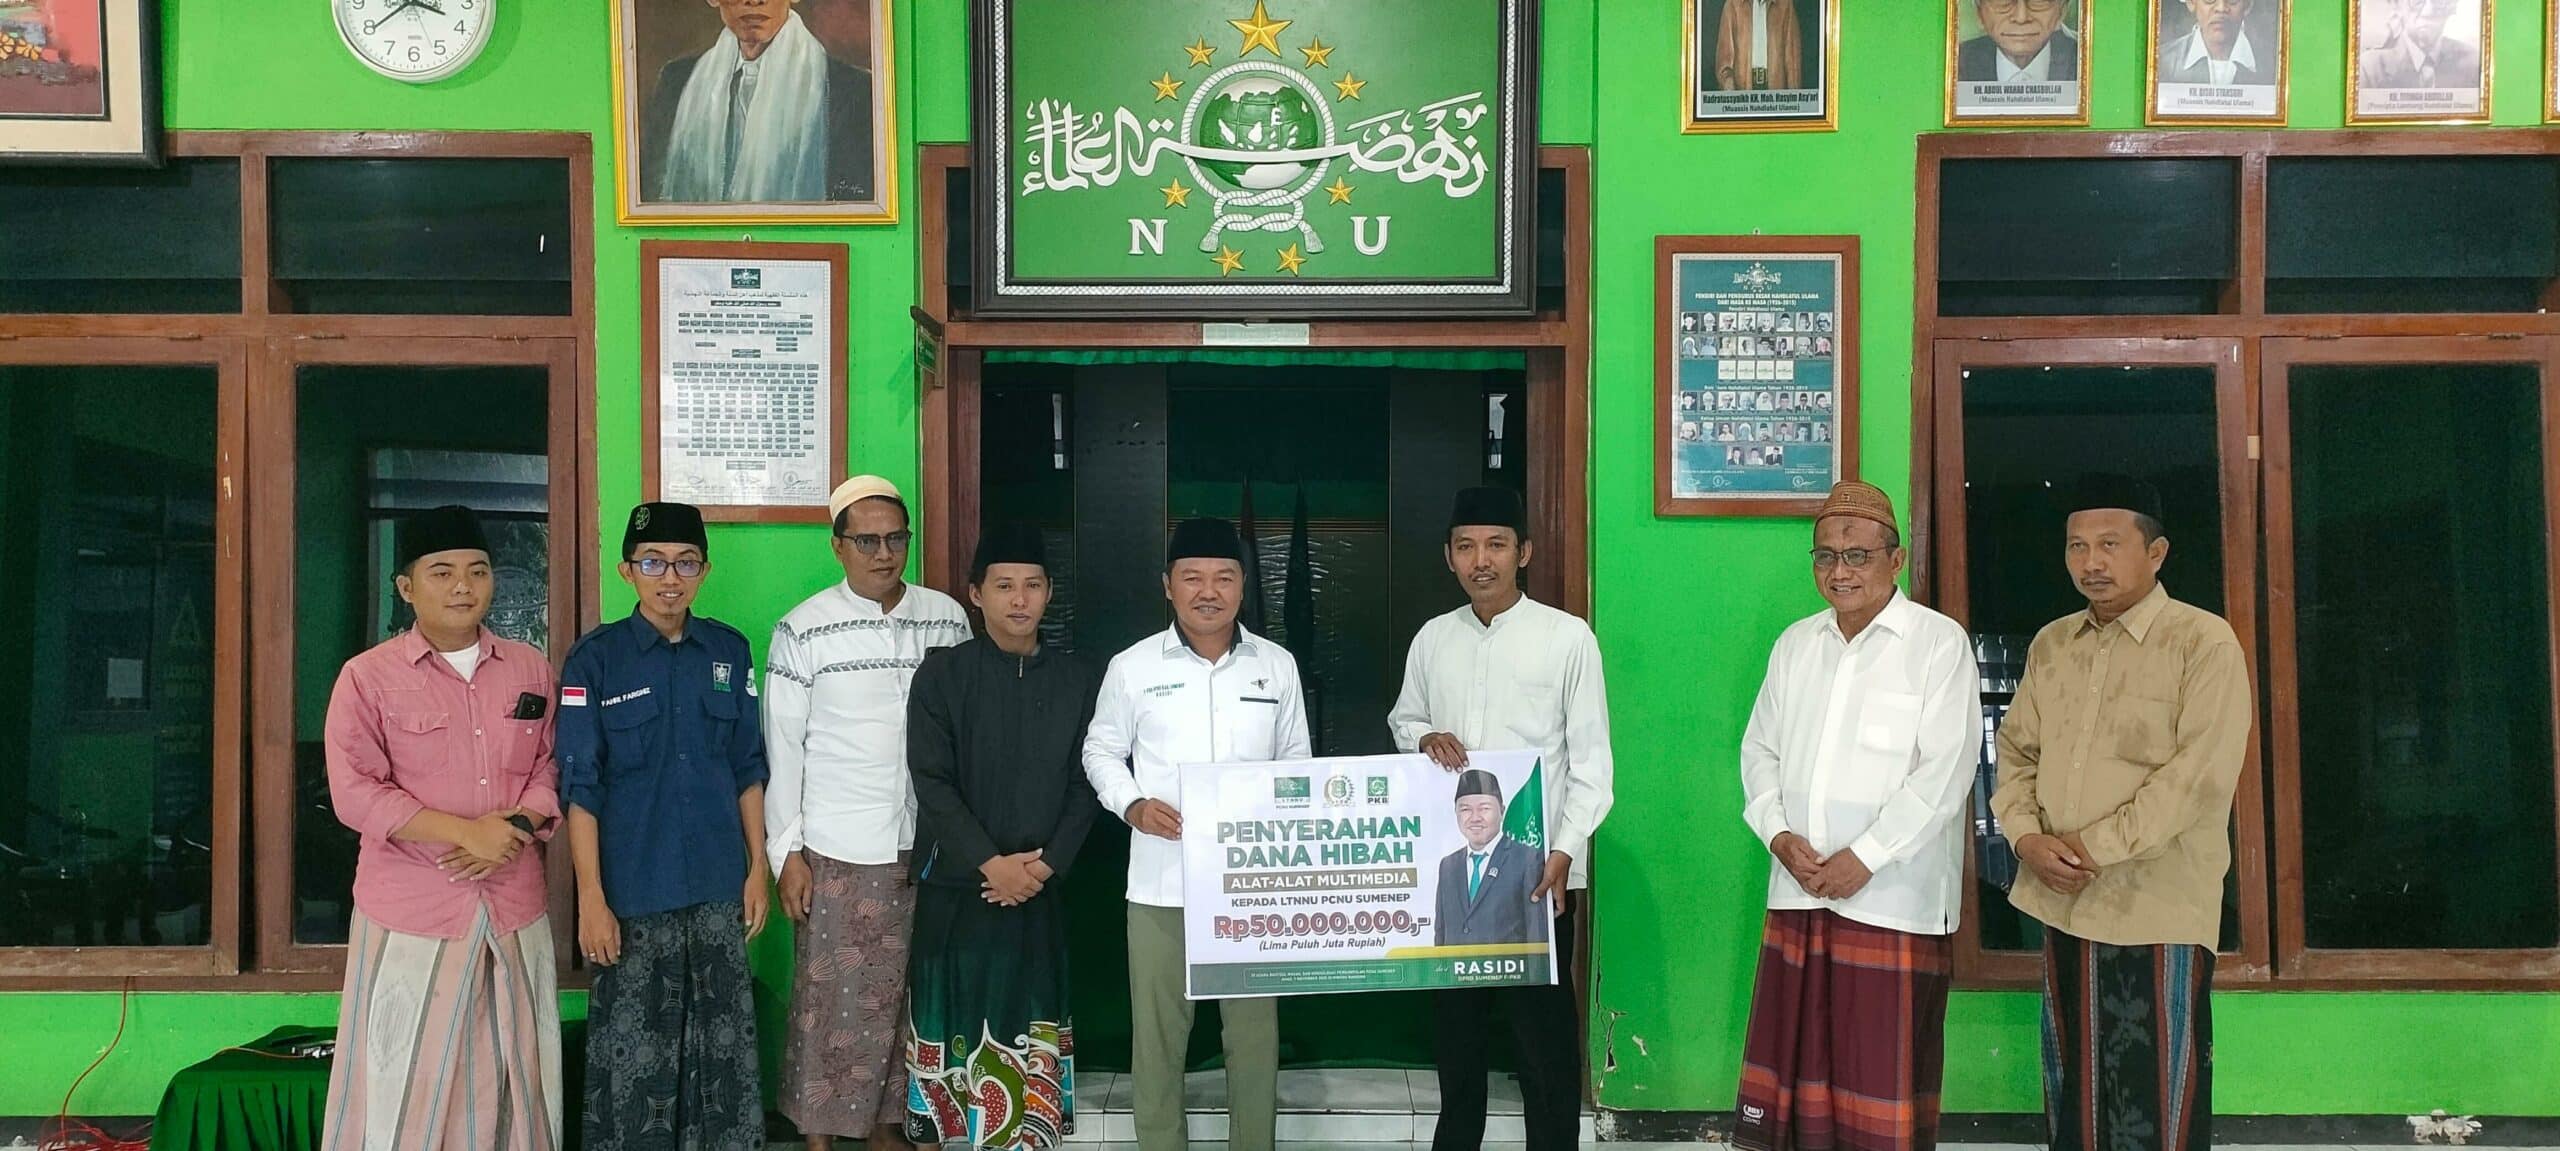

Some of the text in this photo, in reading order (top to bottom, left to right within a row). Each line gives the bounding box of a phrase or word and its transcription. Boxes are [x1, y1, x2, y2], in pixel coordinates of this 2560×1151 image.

[363, 19, 376, 36] 8
[454, 19, 466, 35] 4
[384, 40, 396, 56] 7
[407, 46, 421, 63] 6
[433, 39, 446, 56] 5
[1128, 215, 1391, 256] N U
[1217, 816, 1421, 844] PENYERAHAN
[1227, 841, 1413, 868] DANA HIBAH
[1231, 872, 1410, 889] ALAT-ALAT MULTIMEDIA
[1231, 893, 1410, 907] KEPADA LTNNU PCNU SUMENEP
[1214, 909, 1431, 942] Rp50.000.000,-
[1260, 937, 1386, 951] (Lima Puluh Juta Rupiah)
[1454, 959, 1525, 974] RASIDI
